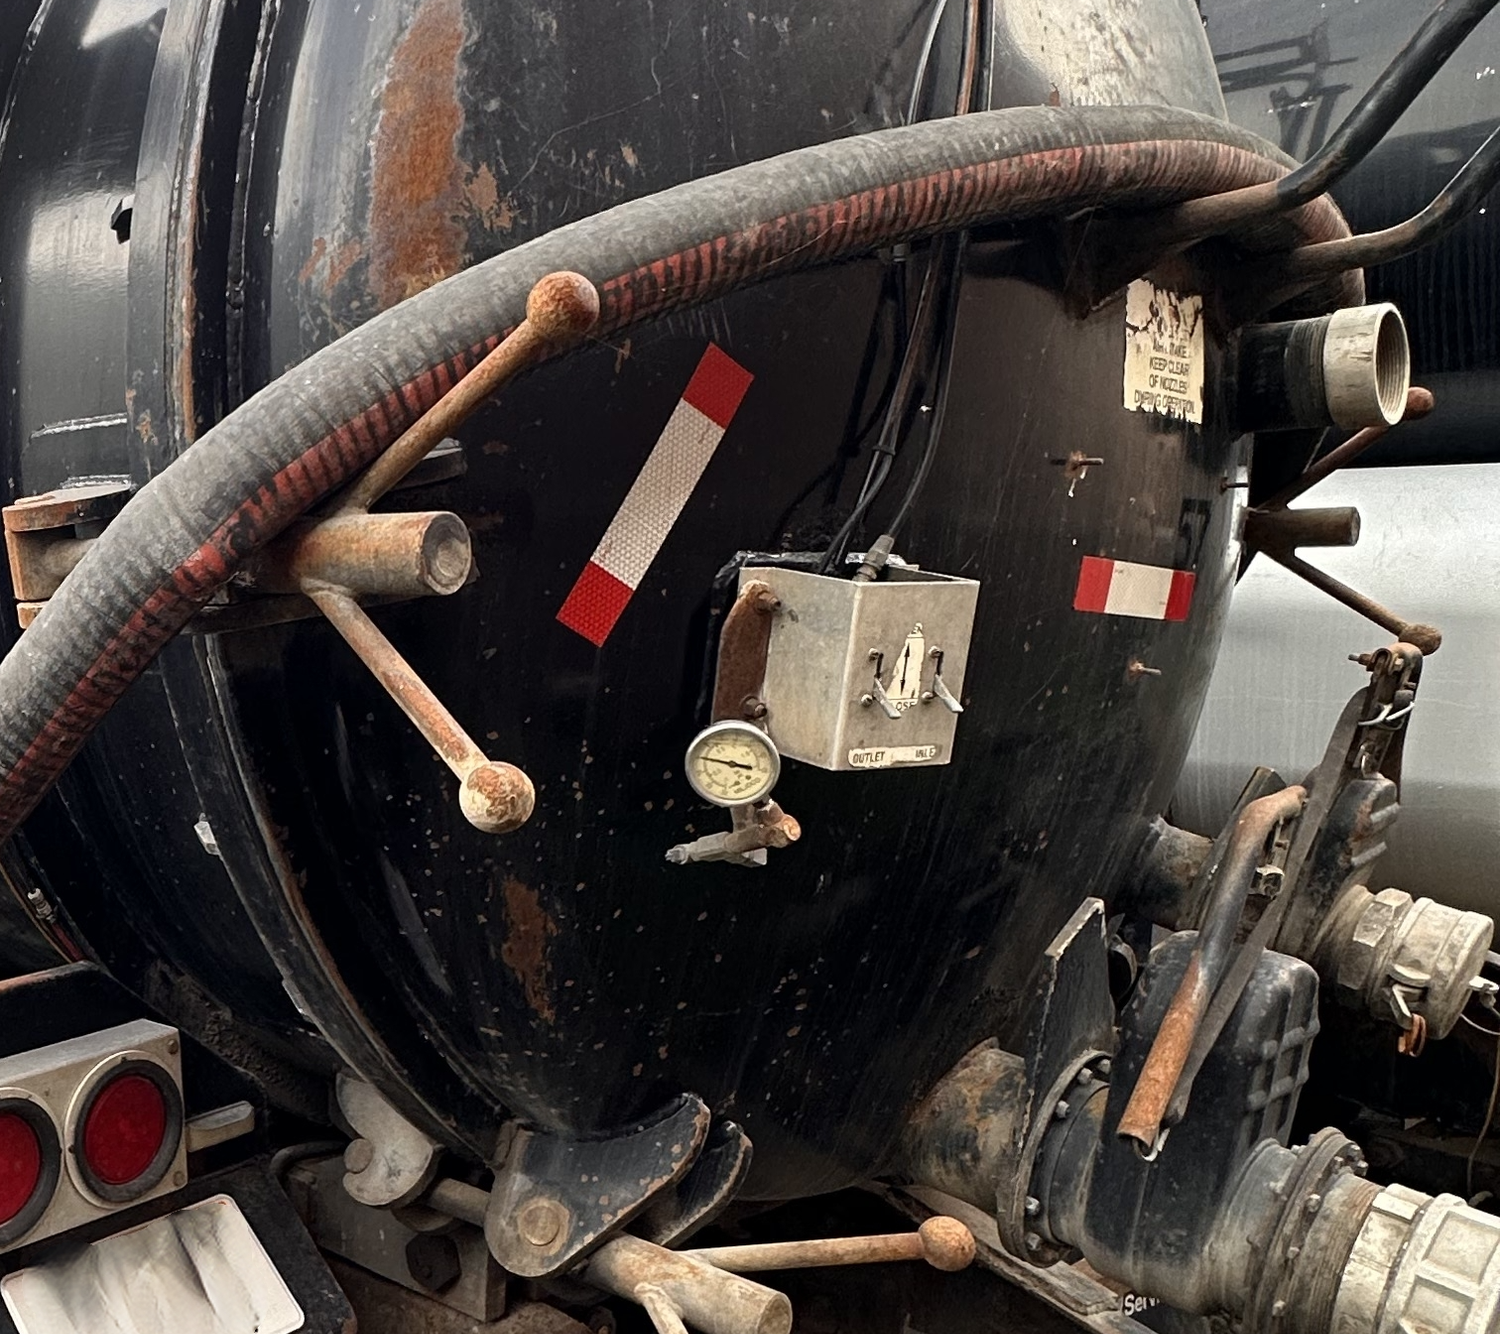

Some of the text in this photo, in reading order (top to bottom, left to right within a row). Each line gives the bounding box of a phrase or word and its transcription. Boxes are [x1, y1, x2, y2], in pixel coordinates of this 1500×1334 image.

[1150, 356, 1190, 376] KEEP CLEAR
[1149, 374, 1159, 387] OF
[853, 751, 885, 763] OUTLET
[1124, 1293, 1160, 1316] Serv
